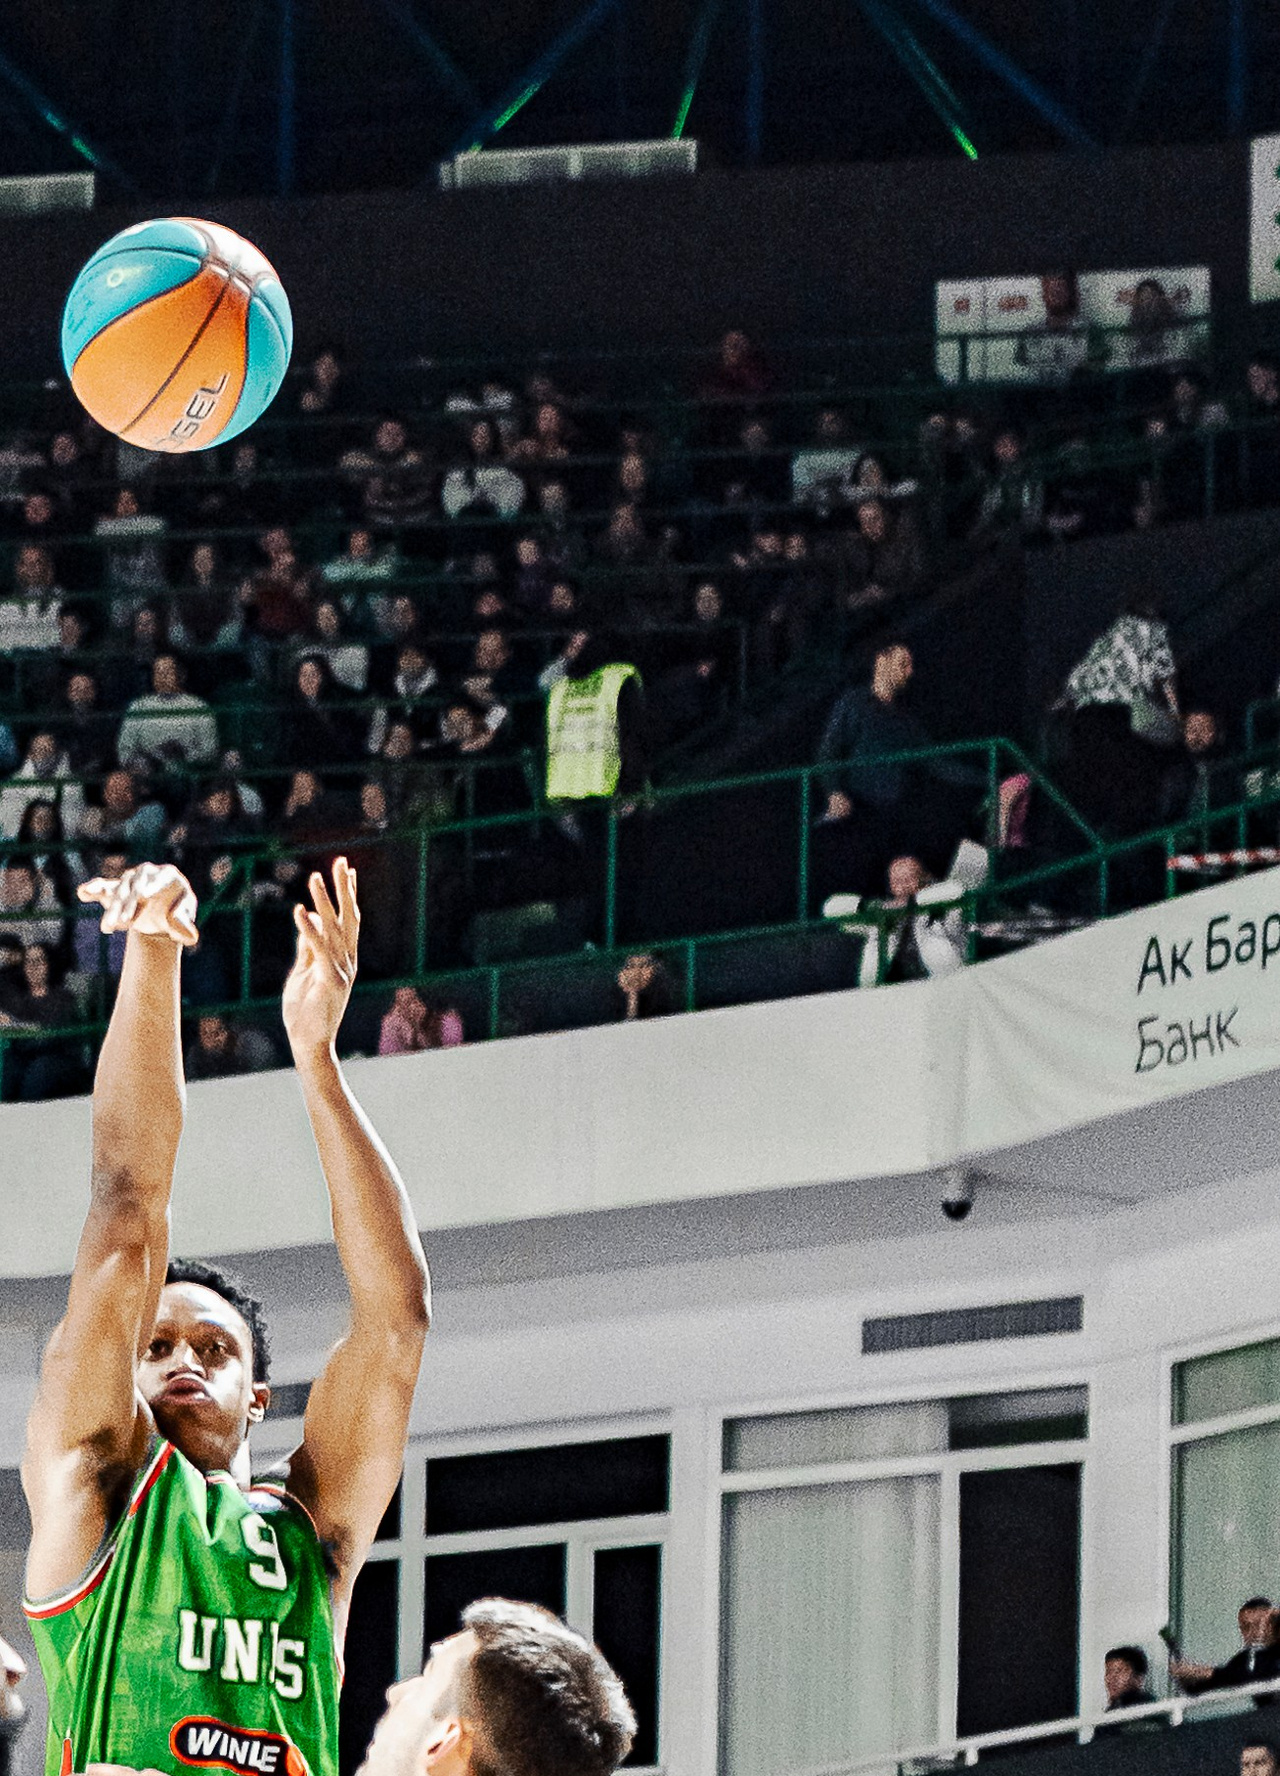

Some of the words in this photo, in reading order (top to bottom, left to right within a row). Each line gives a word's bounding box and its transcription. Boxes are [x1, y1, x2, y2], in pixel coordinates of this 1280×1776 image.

[1137, 935, 1194, 995] Ак
[1135, 1006, 1241, 1074] Банк
[239, 1512, 288, 1591] 9
